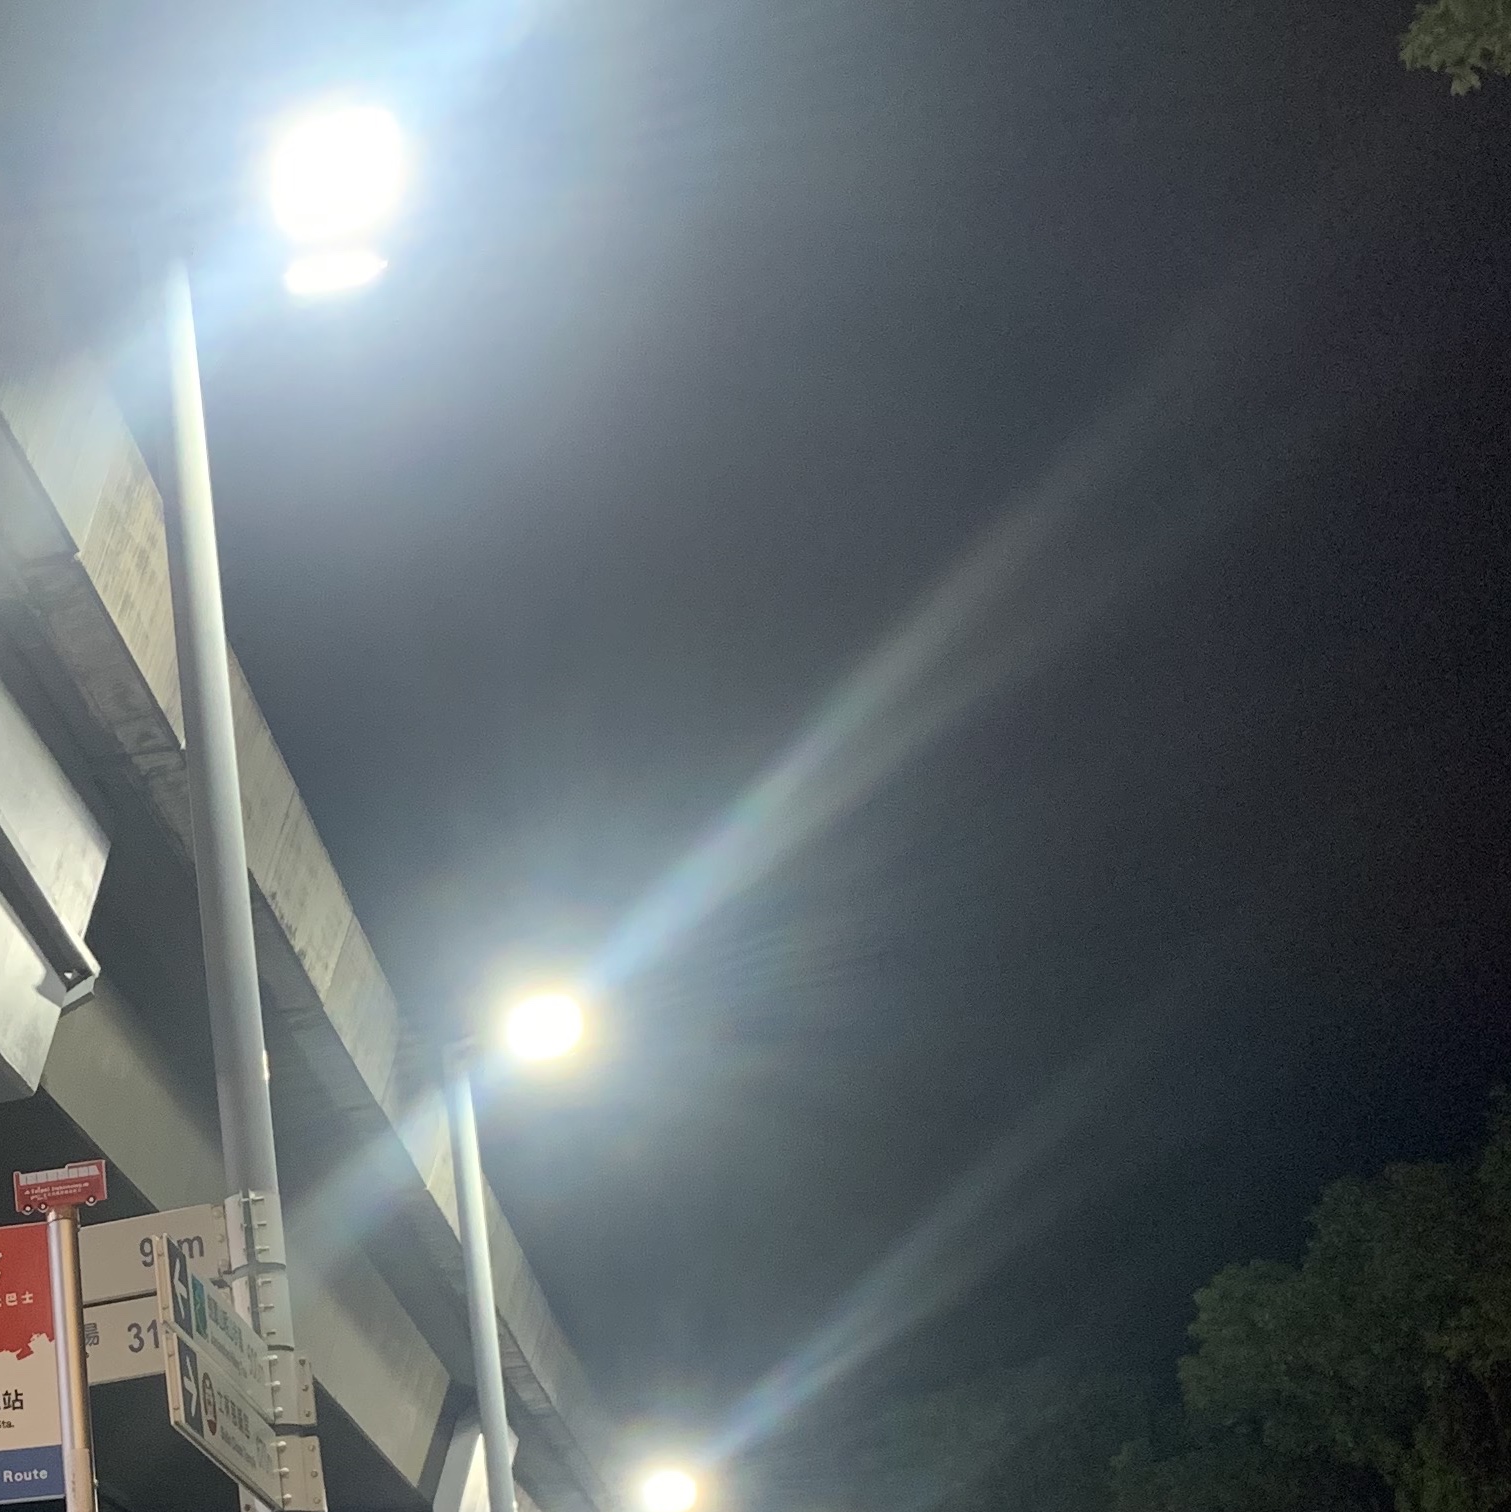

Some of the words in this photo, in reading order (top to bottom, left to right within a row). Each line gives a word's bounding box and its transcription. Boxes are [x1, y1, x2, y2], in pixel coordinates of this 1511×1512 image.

[140, 1235, 205, 1268] 9m
[127, 1319, 160, 1353] 31
[3, 1469, 48, 1483] Route
